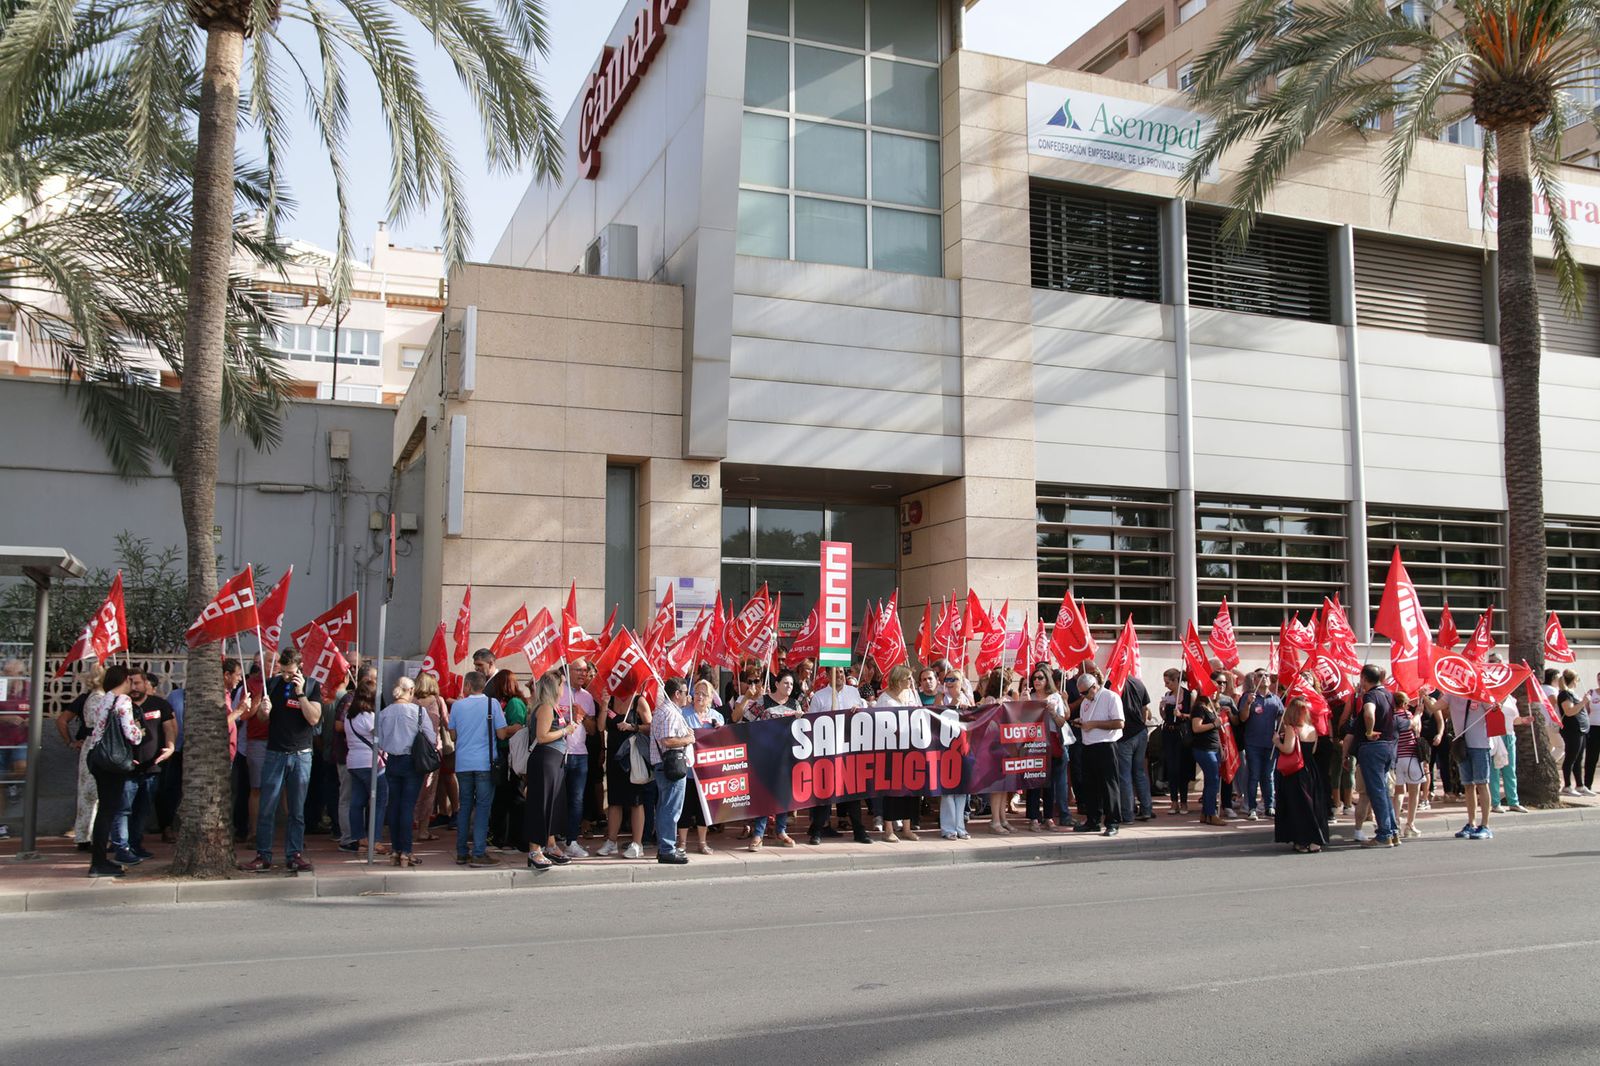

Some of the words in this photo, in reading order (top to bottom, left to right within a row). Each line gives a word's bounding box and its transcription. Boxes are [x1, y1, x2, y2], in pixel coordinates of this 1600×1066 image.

[1089, 102, 1201, 152] Asempal
[1038, 138, 1087, 157] CONFEDERACIÓN
[1088, 146, 1127, 163] EMPRESARIAL
[1128, 154, 1138, 163] DE
[1137, 155, 1146, 166] LA
[1146, 157, 1176, 171] PROVINCIA
[693, 476, 709, 488] 29
[825, 546, 847, 645] CCOO
[1440, 660, 1476, 687] UGT
[791, 709, 932, 759] SALARIO
[1003, 726, 1028, 739] UGT
[697, 748, 735, 765] CCOO
[1005, 758, 1035, 772] CCOO
[722, 761, 749, 773] Almería
[1023, 771, 1047, 780] Almería
[791, 750, 963, 803] CONFLICTO
[700, 780, 727, 797] UGT
